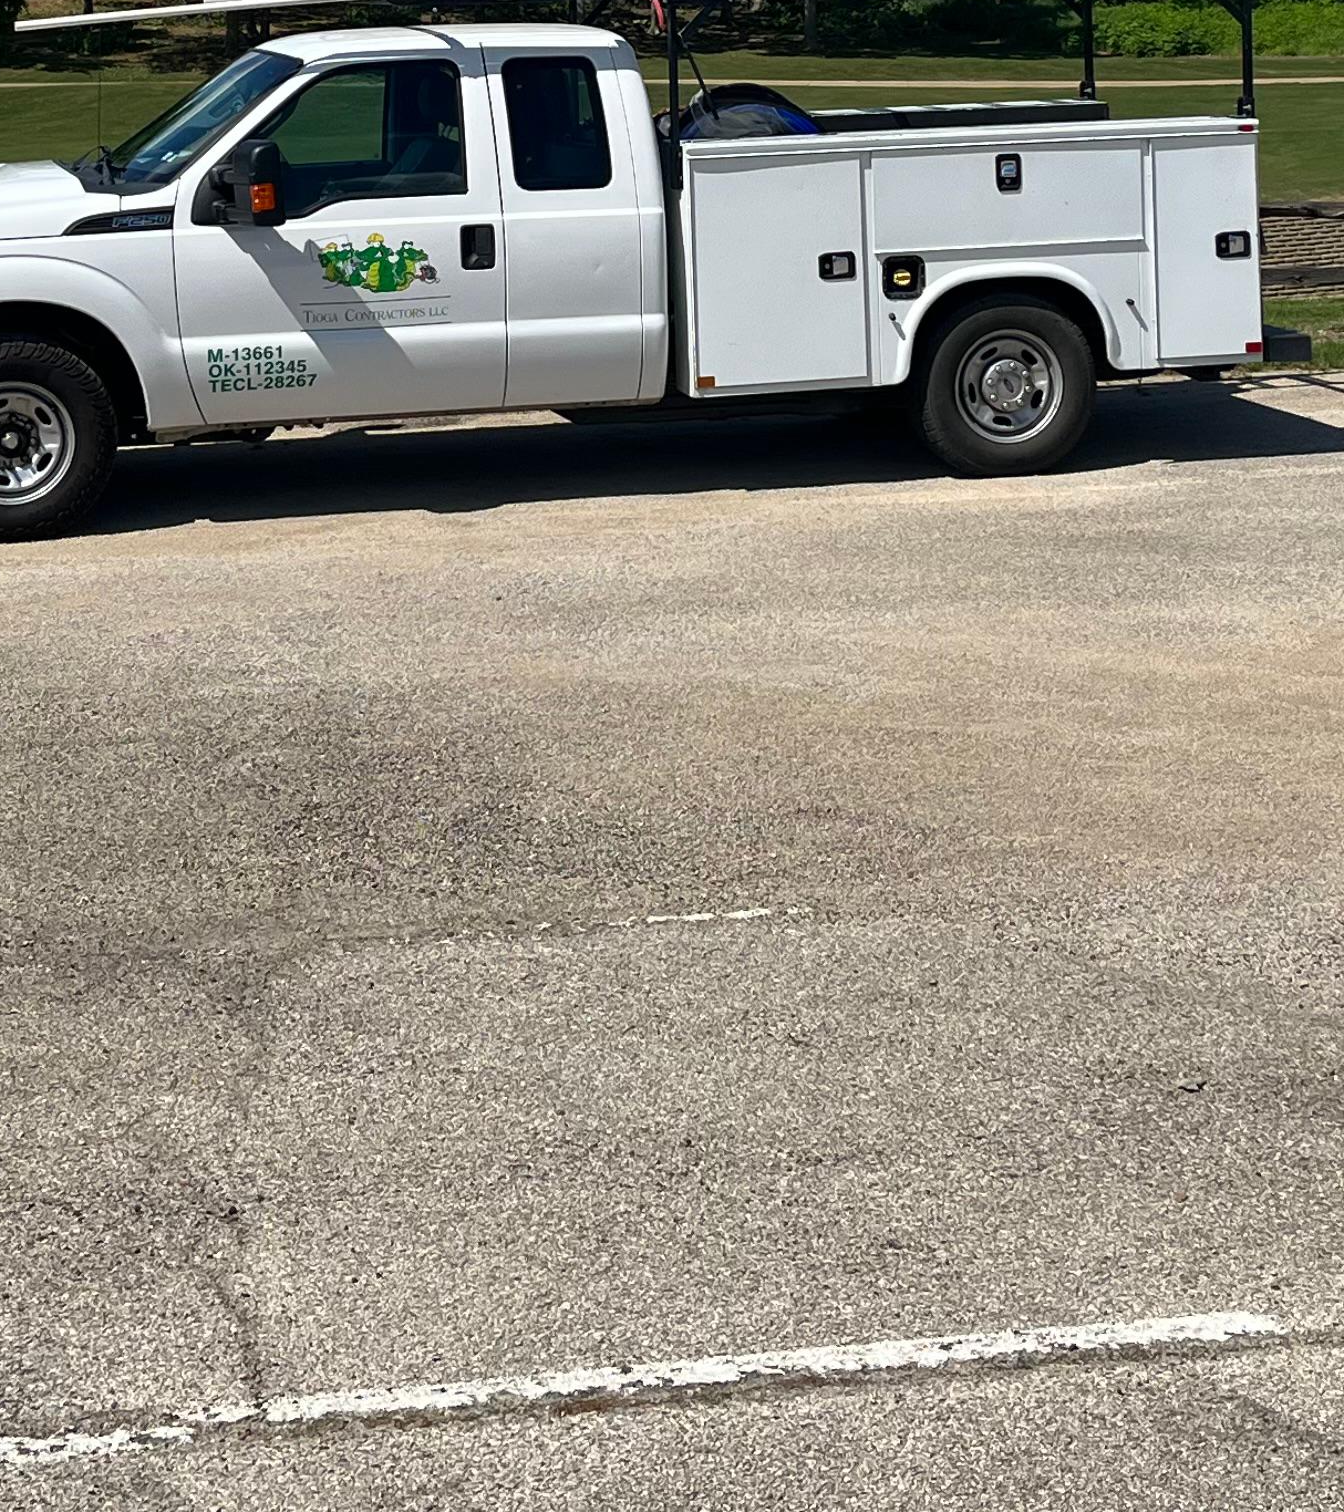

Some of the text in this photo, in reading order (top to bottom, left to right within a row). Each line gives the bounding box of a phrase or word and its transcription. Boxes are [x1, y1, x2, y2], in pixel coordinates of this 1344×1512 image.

[303, 306, 449, 324] TIOGA CONTRACTORS LLC
[208, 345, 283, 363] M-13661
[208, 360, 307, 378] OK-112345
[208, 374, 317, 393] TECL-28267
